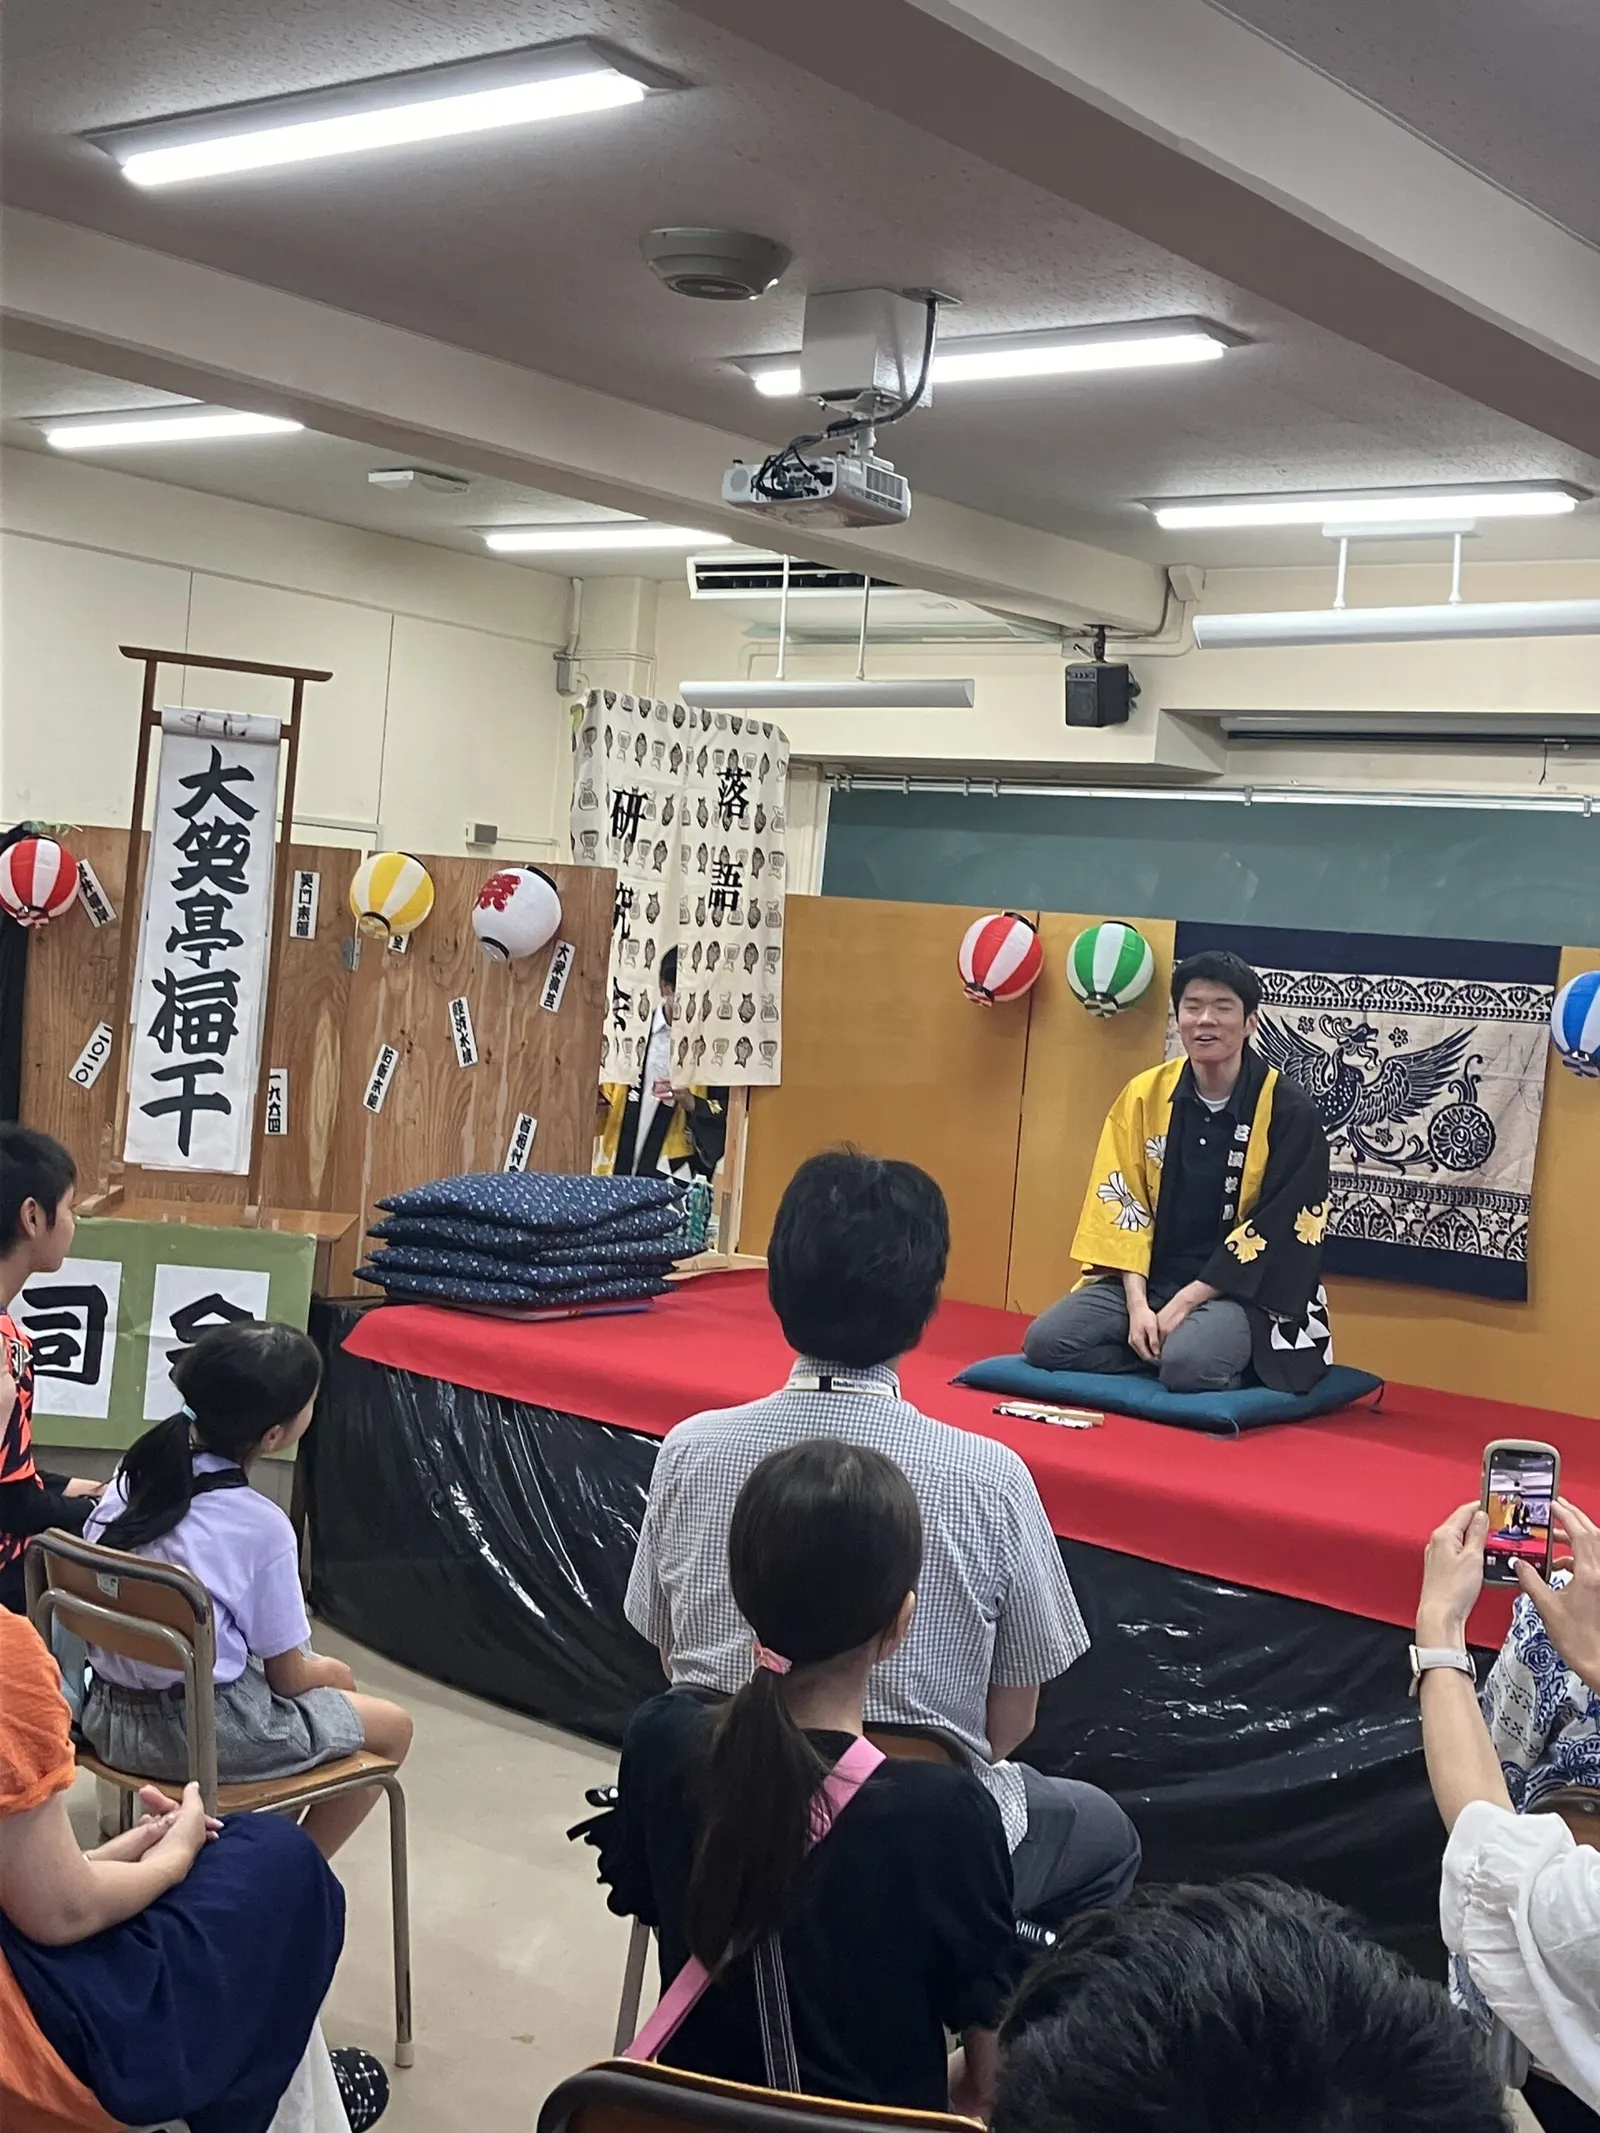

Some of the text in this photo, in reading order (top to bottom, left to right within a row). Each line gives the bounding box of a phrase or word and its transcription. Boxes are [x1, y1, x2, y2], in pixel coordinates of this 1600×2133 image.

[708, 767, 751, 912] 落語
[267, 1075, 281, 1132] 一九六四
